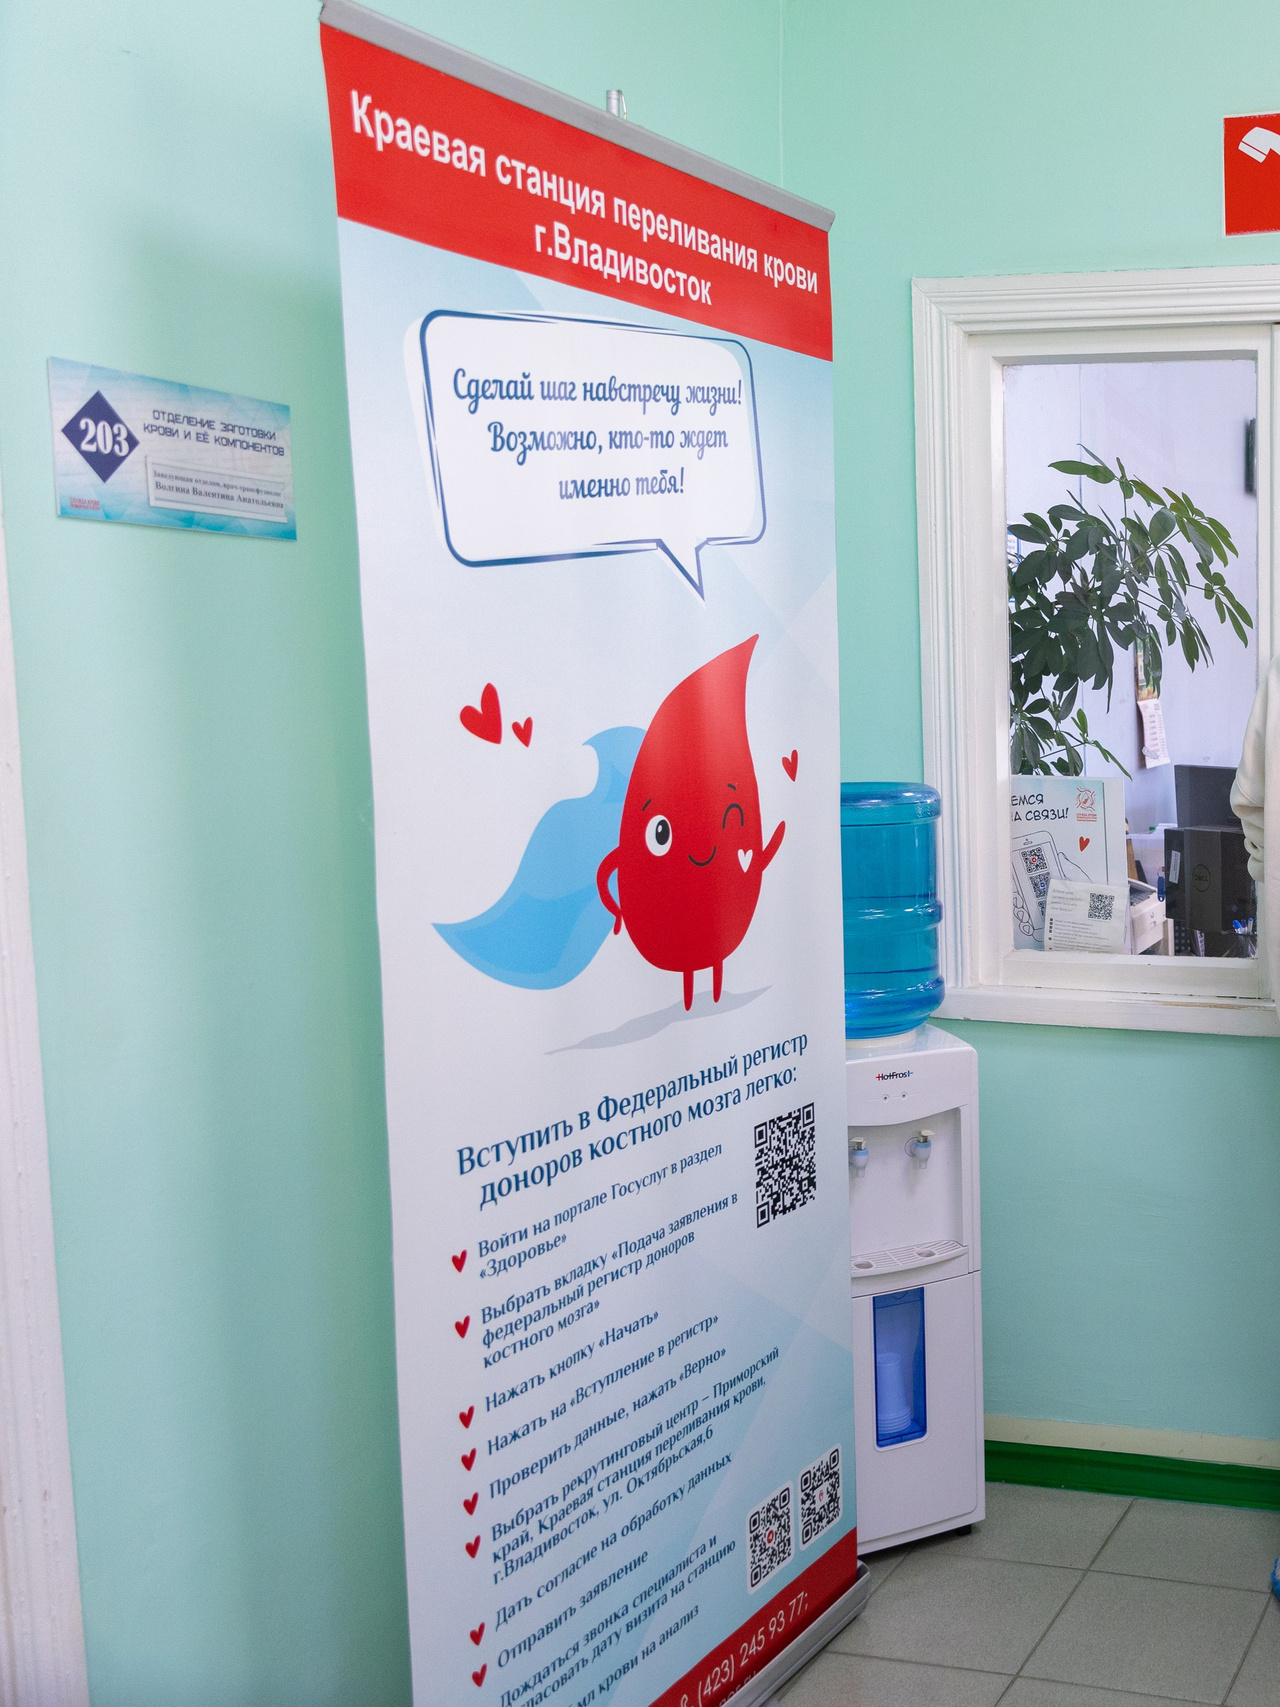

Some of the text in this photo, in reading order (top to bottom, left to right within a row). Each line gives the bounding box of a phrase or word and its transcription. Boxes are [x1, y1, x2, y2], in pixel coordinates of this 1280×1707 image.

[350, 88, 819, 295] Краевая станция переливания крови
[535, 223, 713, 306] г.Владивосток
[79, 418, 131, 457] 203
[143, 423, 285, 456] КРОВИ И ЕЁ КОМПОНЕНТОВ
[152, 409, 277, 441] ОТДЕЛЕНИЕ ЗАГОТОВКИ
[453, 367, 742, 417] Сделай шаг навстречу жизни!
[487, 421, 729, 466] Возможно, кто-то ждет
[154, 480, 191, 497] Волгина
[192, 485, 235, 502] Валентина
[558, 466, 686, 500] именно тебя!
[1011, 793, 1044, 807] ЕМСЯ
[1025, 807, 1069, 821] СВЯЗИ!
[456, 1031, 809, 1177] Вступить в Федеральный регистр
[479, 1065, 798, 1210] доноров костного мозга легко:
[478, 1142, 723, 1259] Войти на портале Госуслуг в раздел
[479, 1232, 567, 1280] «Здоровье»
[481, 1192, 739, 1324] Выбрать вкладку «Подача заявления в
[482, 1229, 696, 1348] федеральный регистр доноров
[482, 1300, 600, 1369] костного мозга»
[485, 1311, 659, 1412] Нажать кнопку «Начать»
[487, 1314, 718, 1455] Нажать на «Вступление в регистр»
[489, 1347, 726, 1498] Проверить данные, нажать «Верно»
[491, 1494, 559, 1542] Выбрать
[561, 1423, 664, 1496] рекрутинговый
[665, 1397, 699, 1430] центр
[712, 1347, 780, 1395] Приморский
[492, 1377, 766, 1565] край, Краевая станция переливания крови,
[493, 1424, 714, 1585] г.Владивосток, ул. Октябрьская,6
[495, 1451, 733, 1630] Дать согласие на обработку данных
[497, 1551, 649, 1668] Отправить заявление
[500, 1534, 717, 1707] Дождаться звонка специалиста и
[520, 1540, 737, 1707] ласовать дату визита на станцию
[597, 1657, 639, 1698] крови
[640, 1643, 656, 1661] на
[658, 1605, 700, 1645] анализ
[698, 1654, 735, 1707] (423)
[739, 1626, 766, 1668] 245
[768, 1610, 786, 1640] 93
[788, 1591, 809, 1623] 77;
